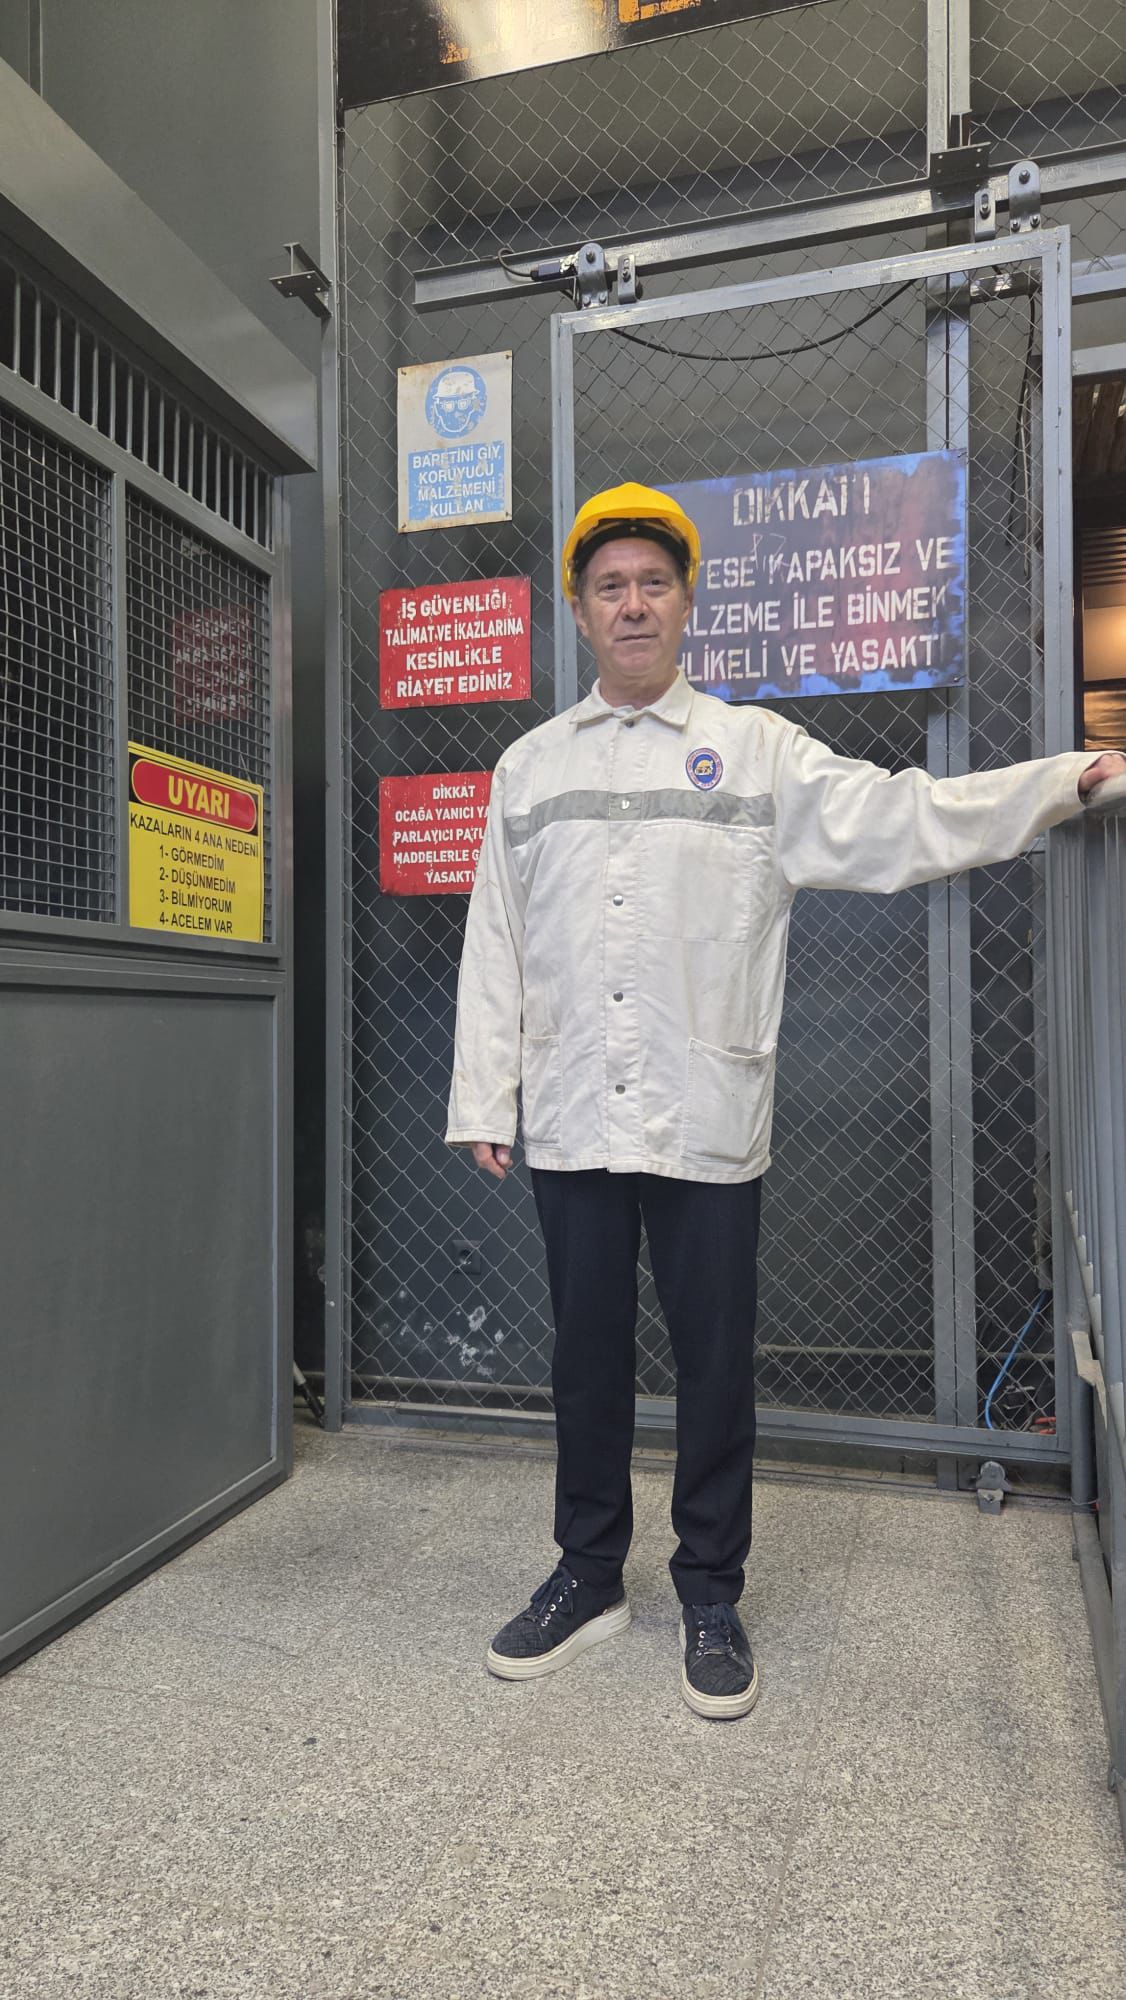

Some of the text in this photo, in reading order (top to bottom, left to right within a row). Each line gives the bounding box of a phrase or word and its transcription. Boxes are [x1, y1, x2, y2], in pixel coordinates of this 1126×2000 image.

[419, 463, 494, 485] KORUYUCU
[418, 477, 495, 501] MALZEMENİ
[430, 499, 484, 516] KULLAN
[699, 536, 955, 590] ESE KAPAKSIZ VE
[401, 598, 417, 620] İŞ
[793, 592, 834, 630] İLE
[385, 623, 435, 647] TALİMAT
[437, 623, 452, 642] VE
[406, 643, 502, 672] KESİNLİKLE
[781, 643, 817, 677] VE
[396, 668, 513, 698] RİAYET EDİNİZ
[168, 774, 230, 820] UYARI
[432, 783, 476, 800] DİKKAT
[395, 807, 433, 823] OCAĞA
[435, 806, 475, 821] YANICI
[130, 812, 192, 842] KAZALARIN
[194, 832, 200, 844] 4
[202, 833, 223, 849] ANA
[394, 828, 453, 844] PARLAYICI
[159, 844, 225, 872] 1- GÖRMEDİM
[393, 849, 470, 865] MADDELERLE
[159, 866, 236, 895] 2- DÜŞÜNMEDİM
[159, 888, 232, 914] 3- BİLMİYORUM
[159, 911, 233, 934] 4- ACELEM VAR
